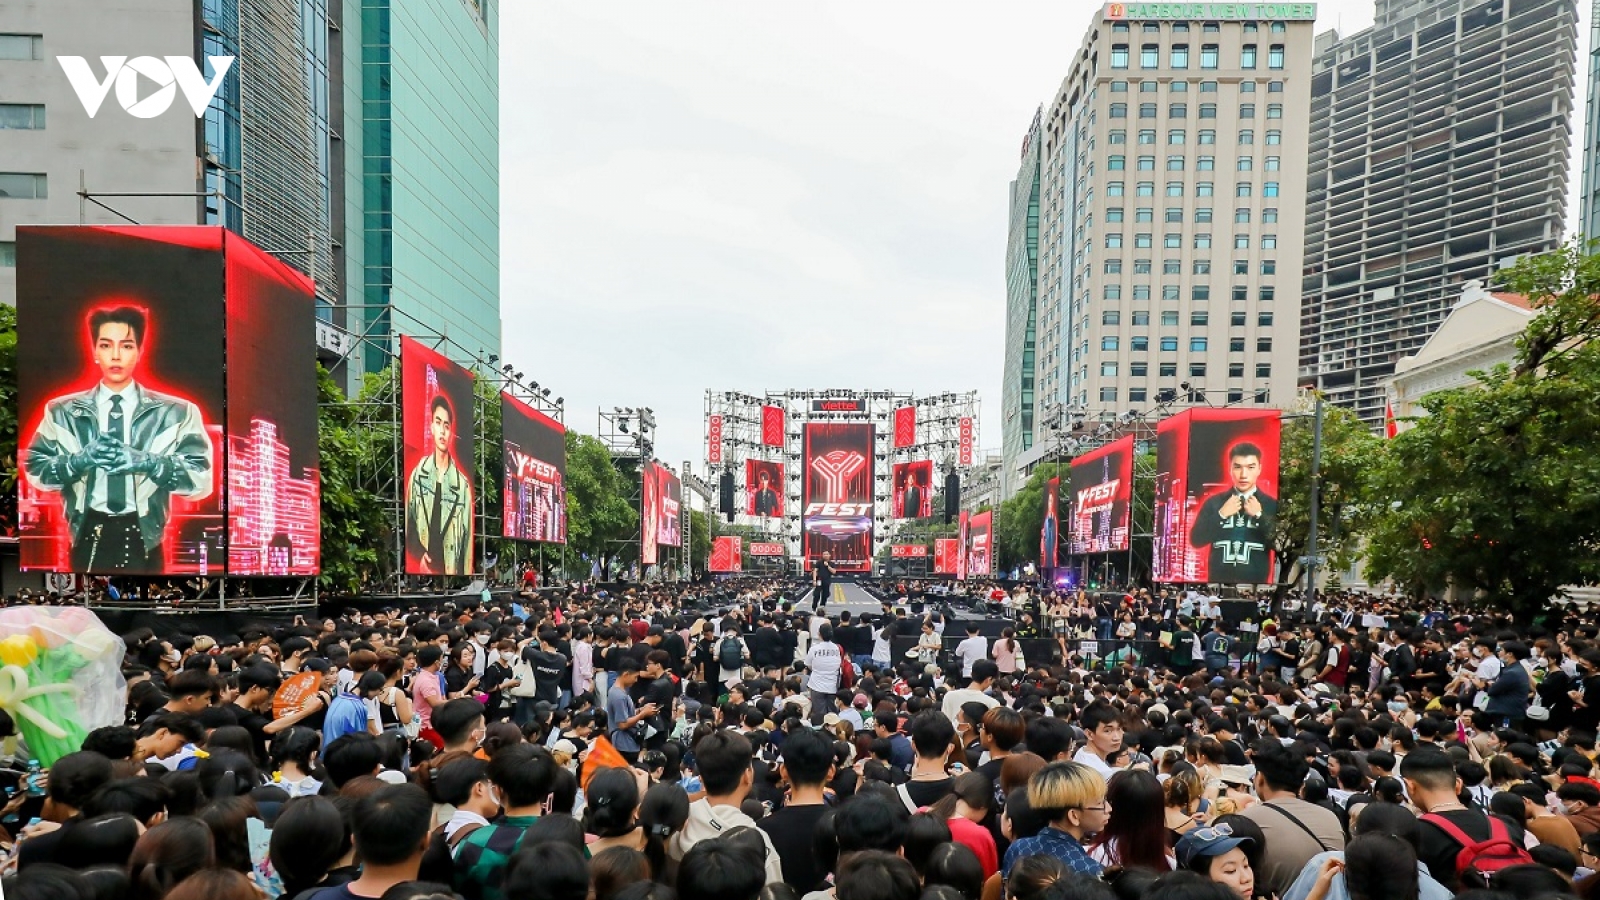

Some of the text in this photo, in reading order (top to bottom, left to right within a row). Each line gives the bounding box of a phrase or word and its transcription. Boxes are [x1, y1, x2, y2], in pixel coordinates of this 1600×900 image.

[1127, 4, 1313, 18] HARBOUR VIEW TOWER
[821, 401, 857, 410] viettel
[804, 502, 873, 516] FEST
